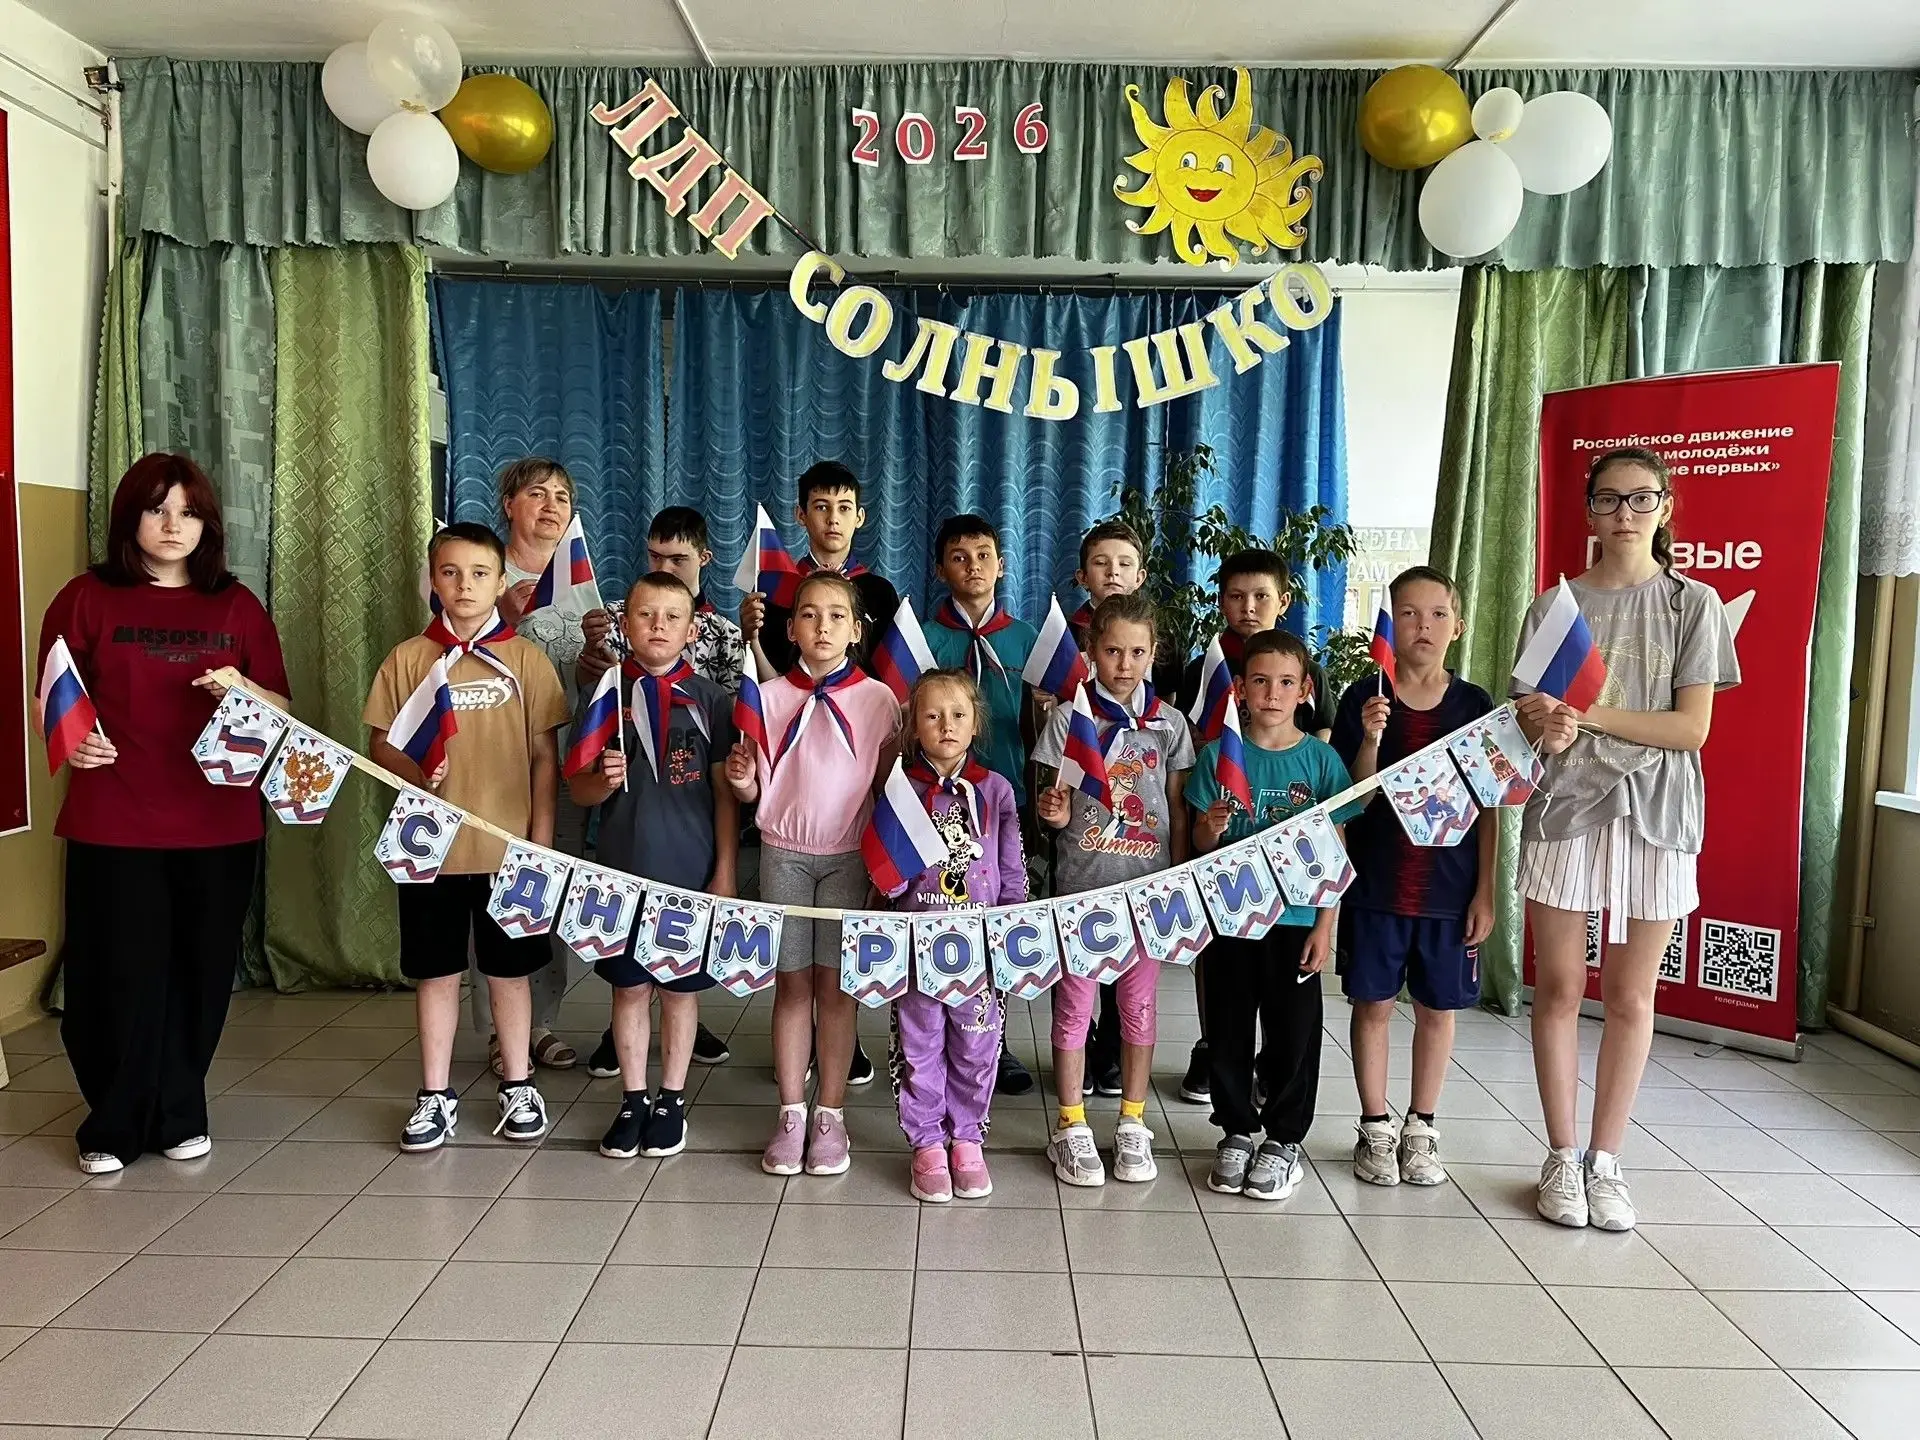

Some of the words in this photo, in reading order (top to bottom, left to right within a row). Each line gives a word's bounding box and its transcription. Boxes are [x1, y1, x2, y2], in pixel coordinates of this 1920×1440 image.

[852, 103, 1049, 167] 2026
[590, 78, 775, 261] ЛДП
[789, 251, 1334, 420] СОЛНЫШКО
[1572, 432, 1685, 451] Российское
[1688, 425, 1794, 445] движение
[1664, 444, 1770, 461] молодёжи
[1693, 461, 1780, 477] первых»
[450, 688, 500, 704] ANSAS
[1079, 825, 1161, 859] Summer
[397, 811, 443, 860] С
[499, 864, 774, 970] ДНЁМ
[854, 832, 1325, 978] РОССИИ!
[917, 892, 954, 905] MINN
